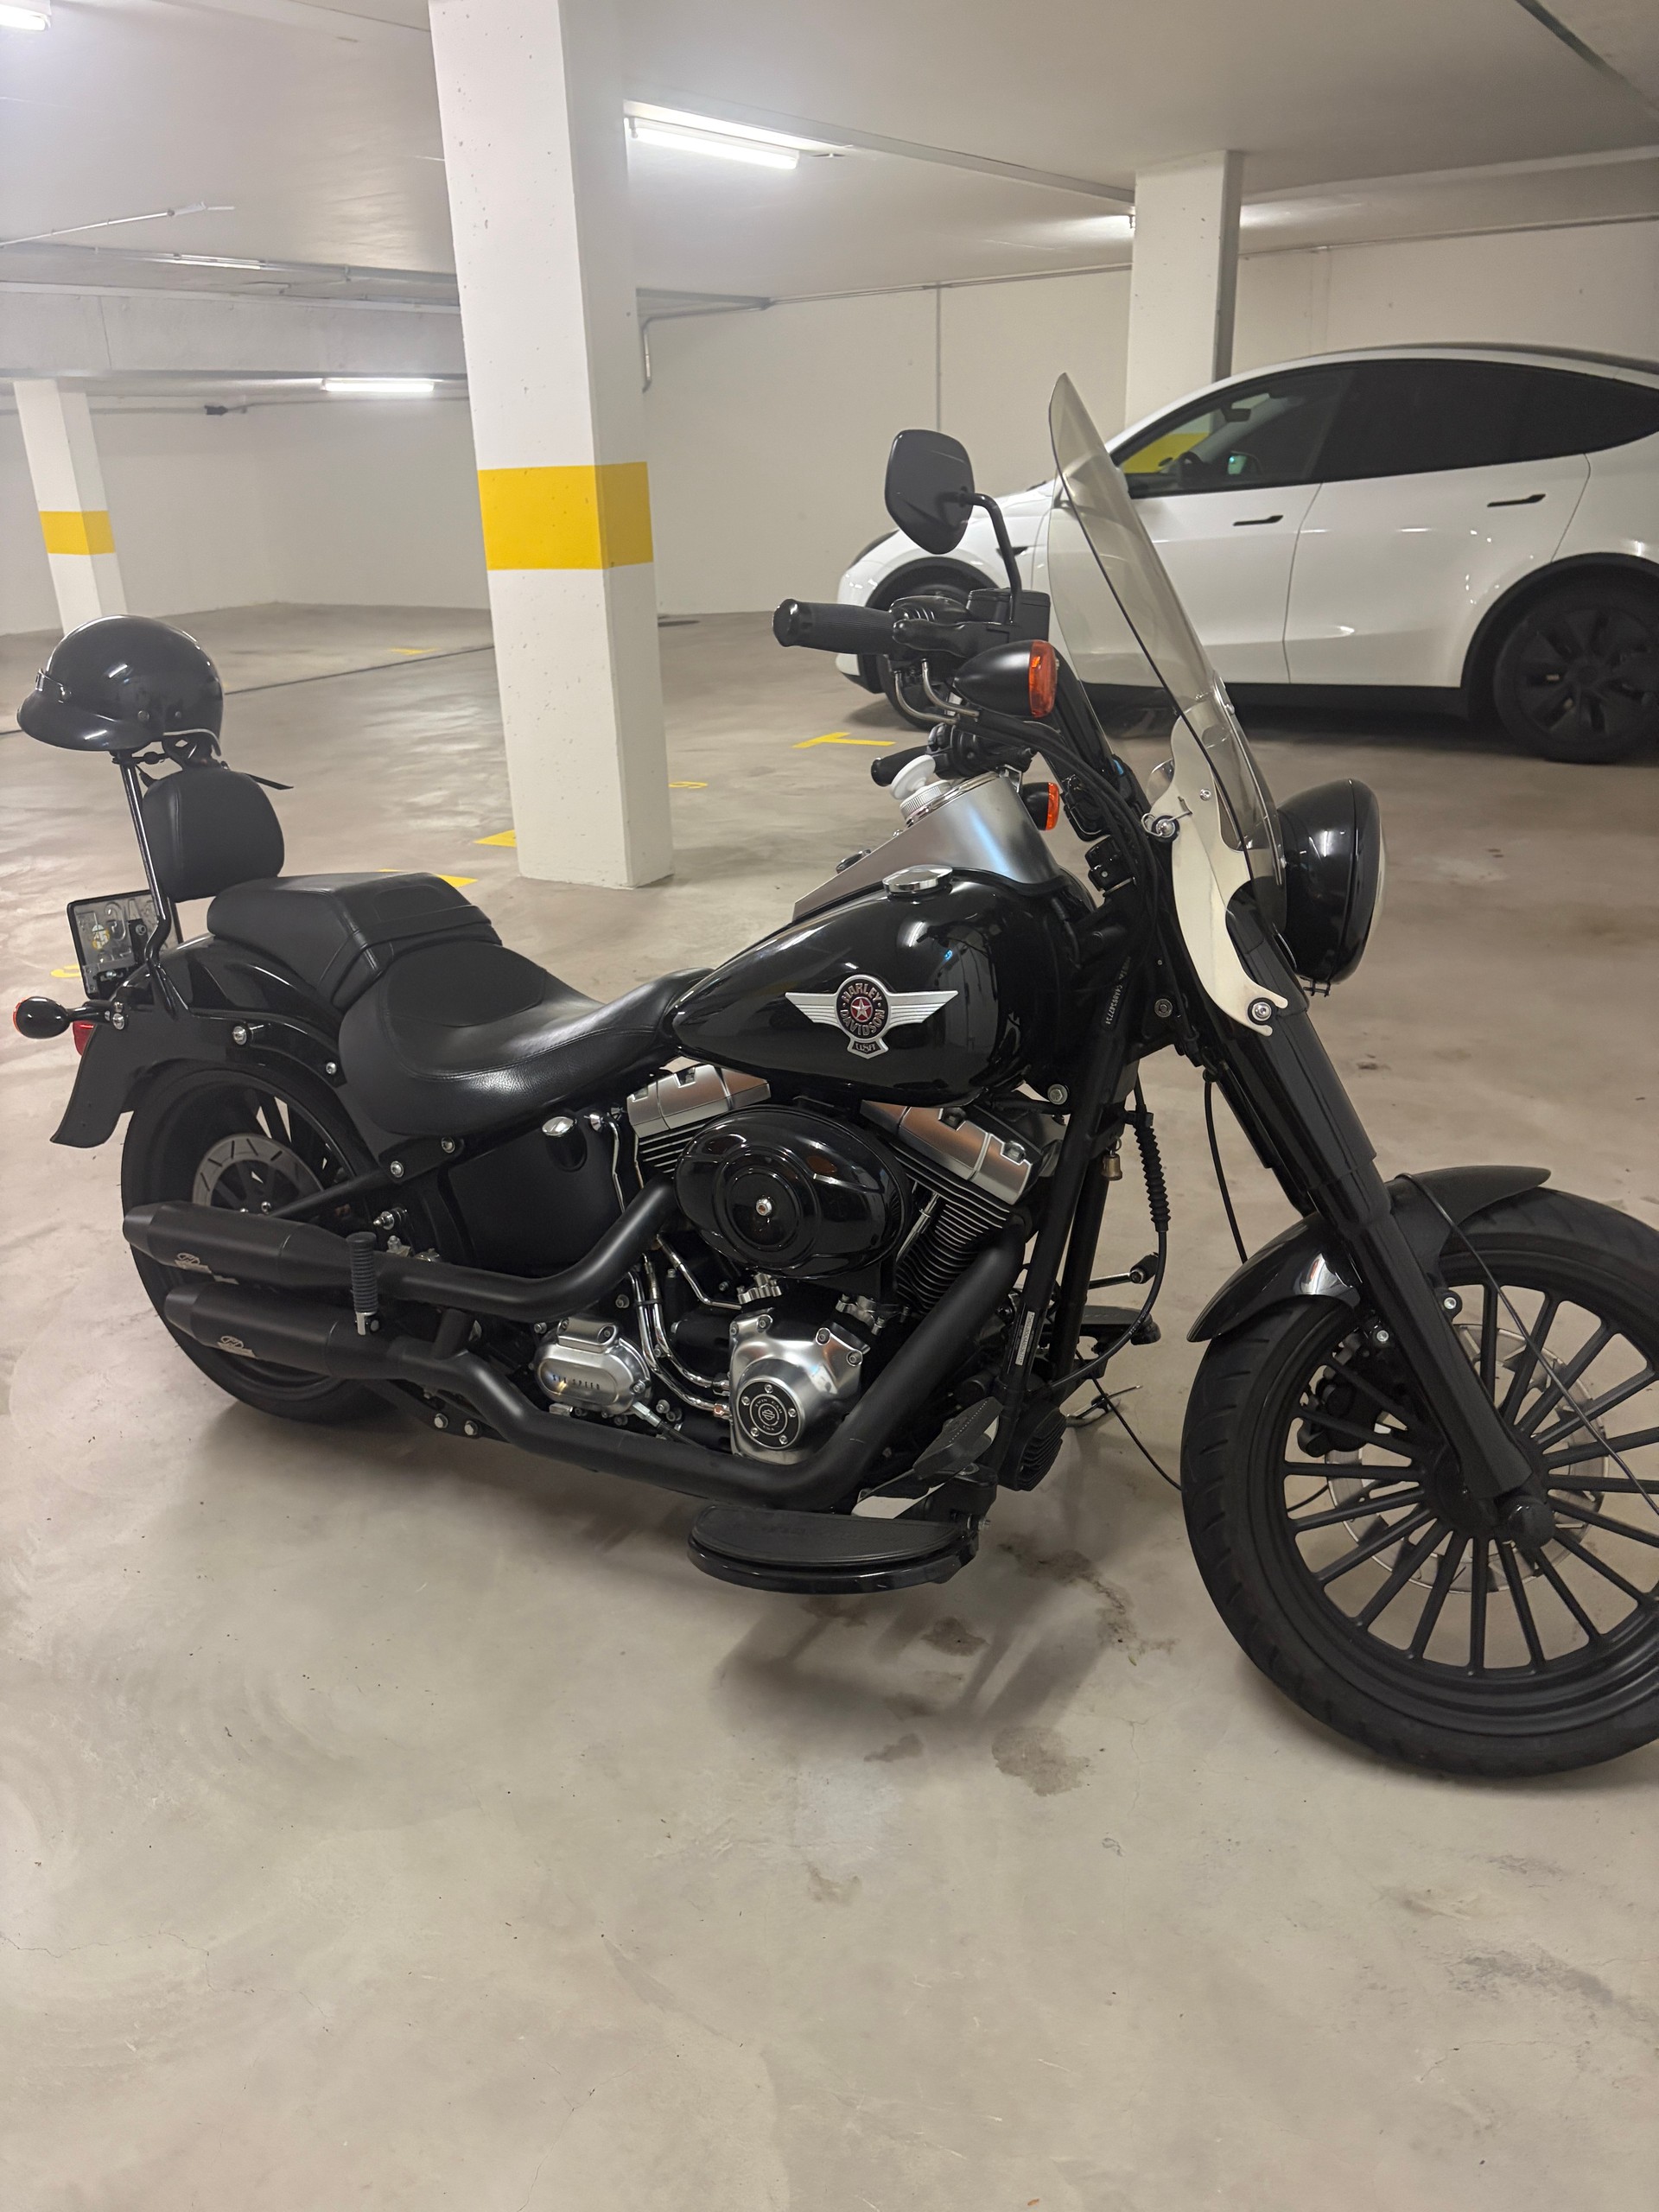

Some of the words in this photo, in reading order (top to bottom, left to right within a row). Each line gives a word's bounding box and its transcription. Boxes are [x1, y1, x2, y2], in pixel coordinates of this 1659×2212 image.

[841, 983, 882, 1003] HARLEY
[840, 1009, 886, 1036] DAVIDSON
[855, 1043, 876, 1052] USA
[572, 1379, 600, 1389] SPEED
